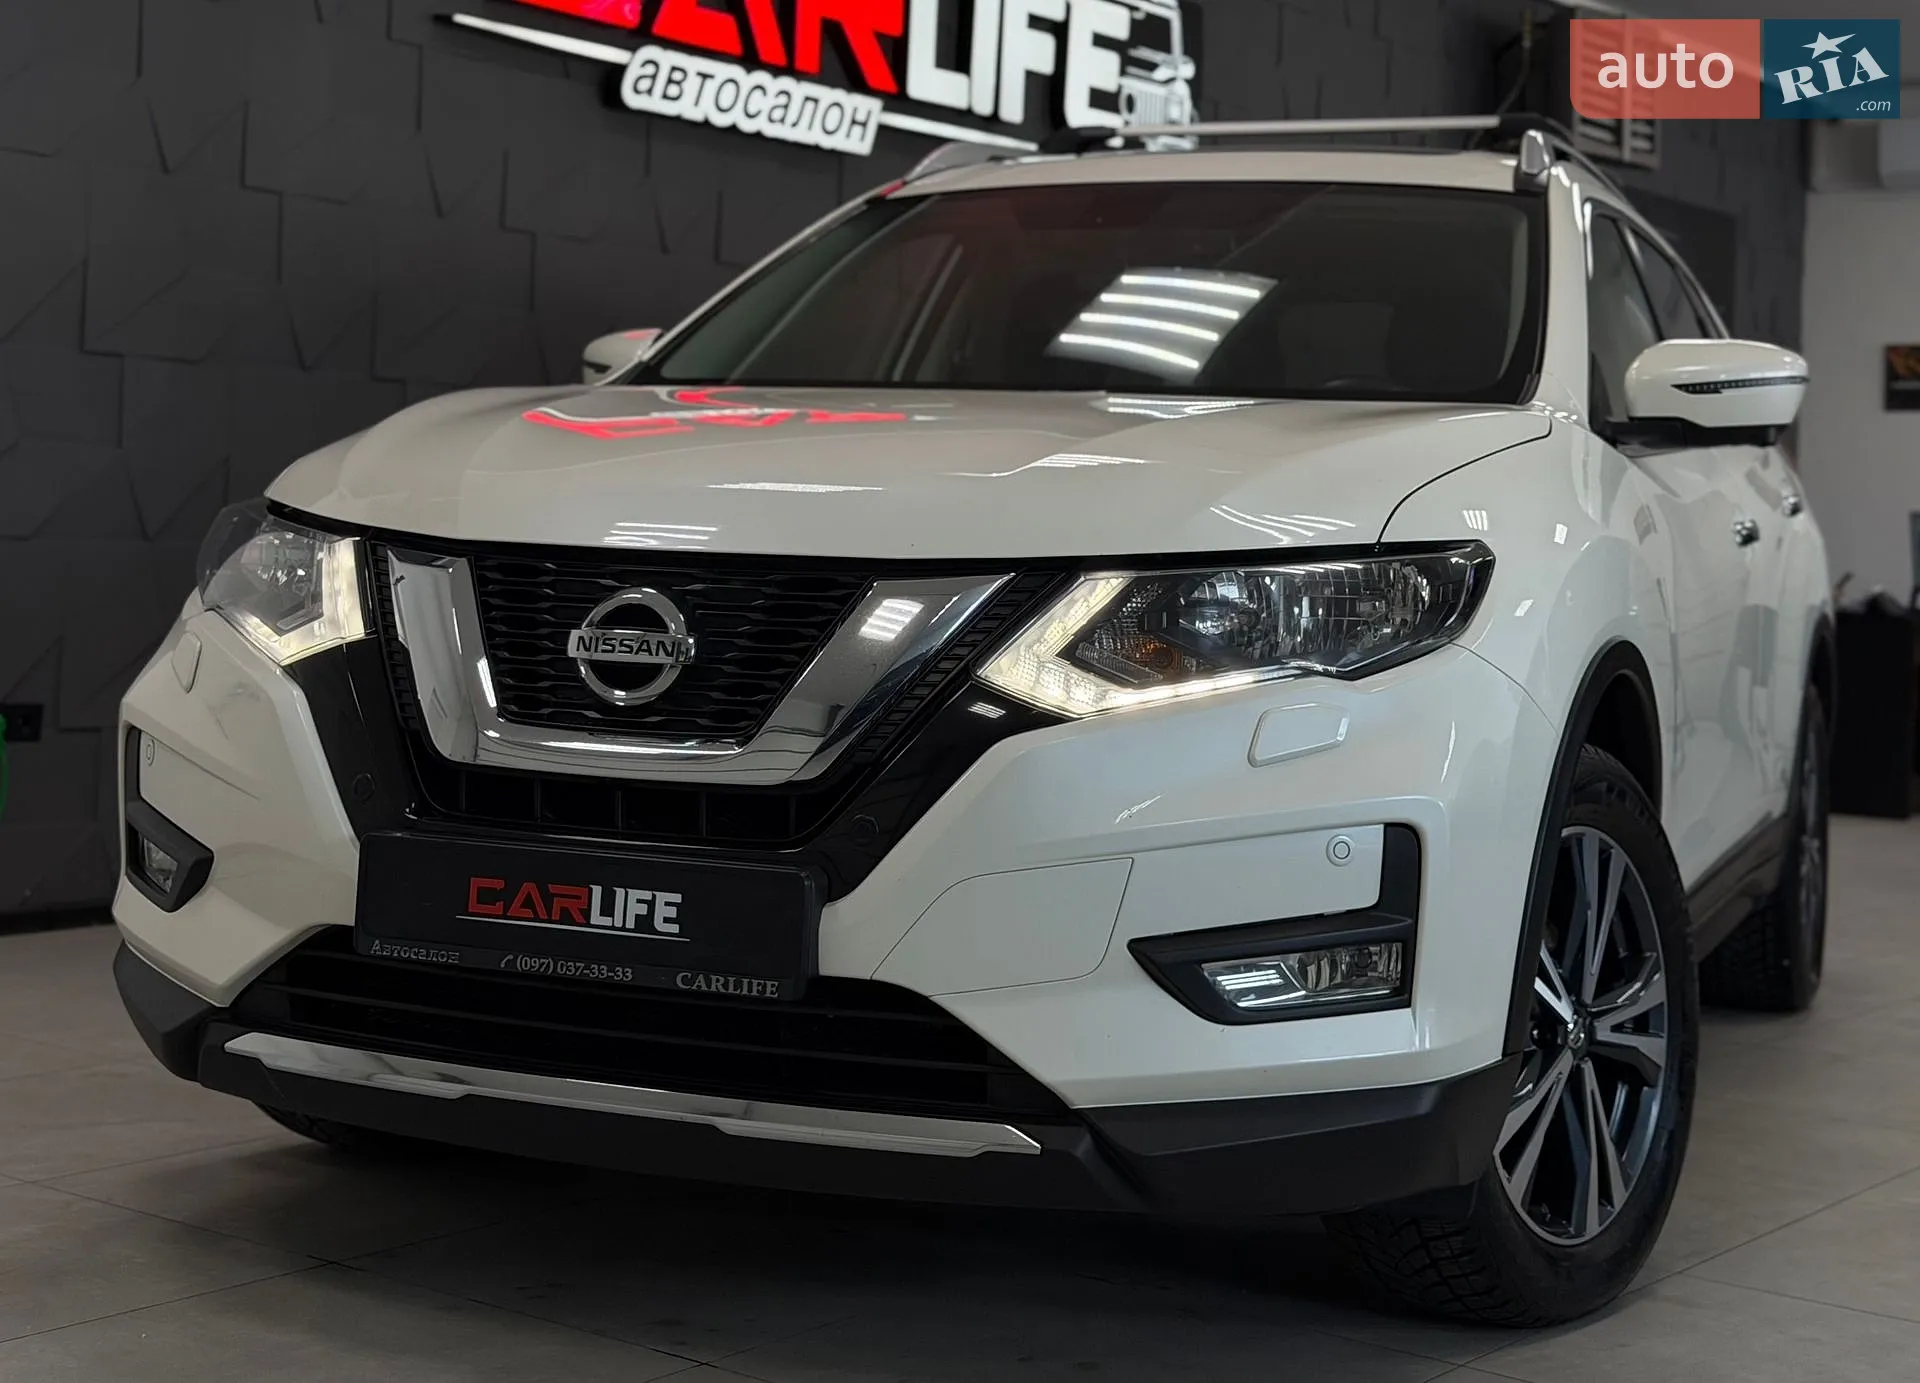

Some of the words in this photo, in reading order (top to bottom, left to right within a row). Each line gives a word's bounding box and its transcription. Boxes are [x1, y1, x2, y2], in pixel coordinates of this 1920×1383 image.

[632, 58, 875, 143] автосалон
[575, 635, 676, 658] NISSAN
[468, 877, 682, 933] CARLIFE
[516, 954, 554, 975] (097)
[557, 956, 633, 982] 037-33-33
[675, 971, 779, 998] CARLIFE
